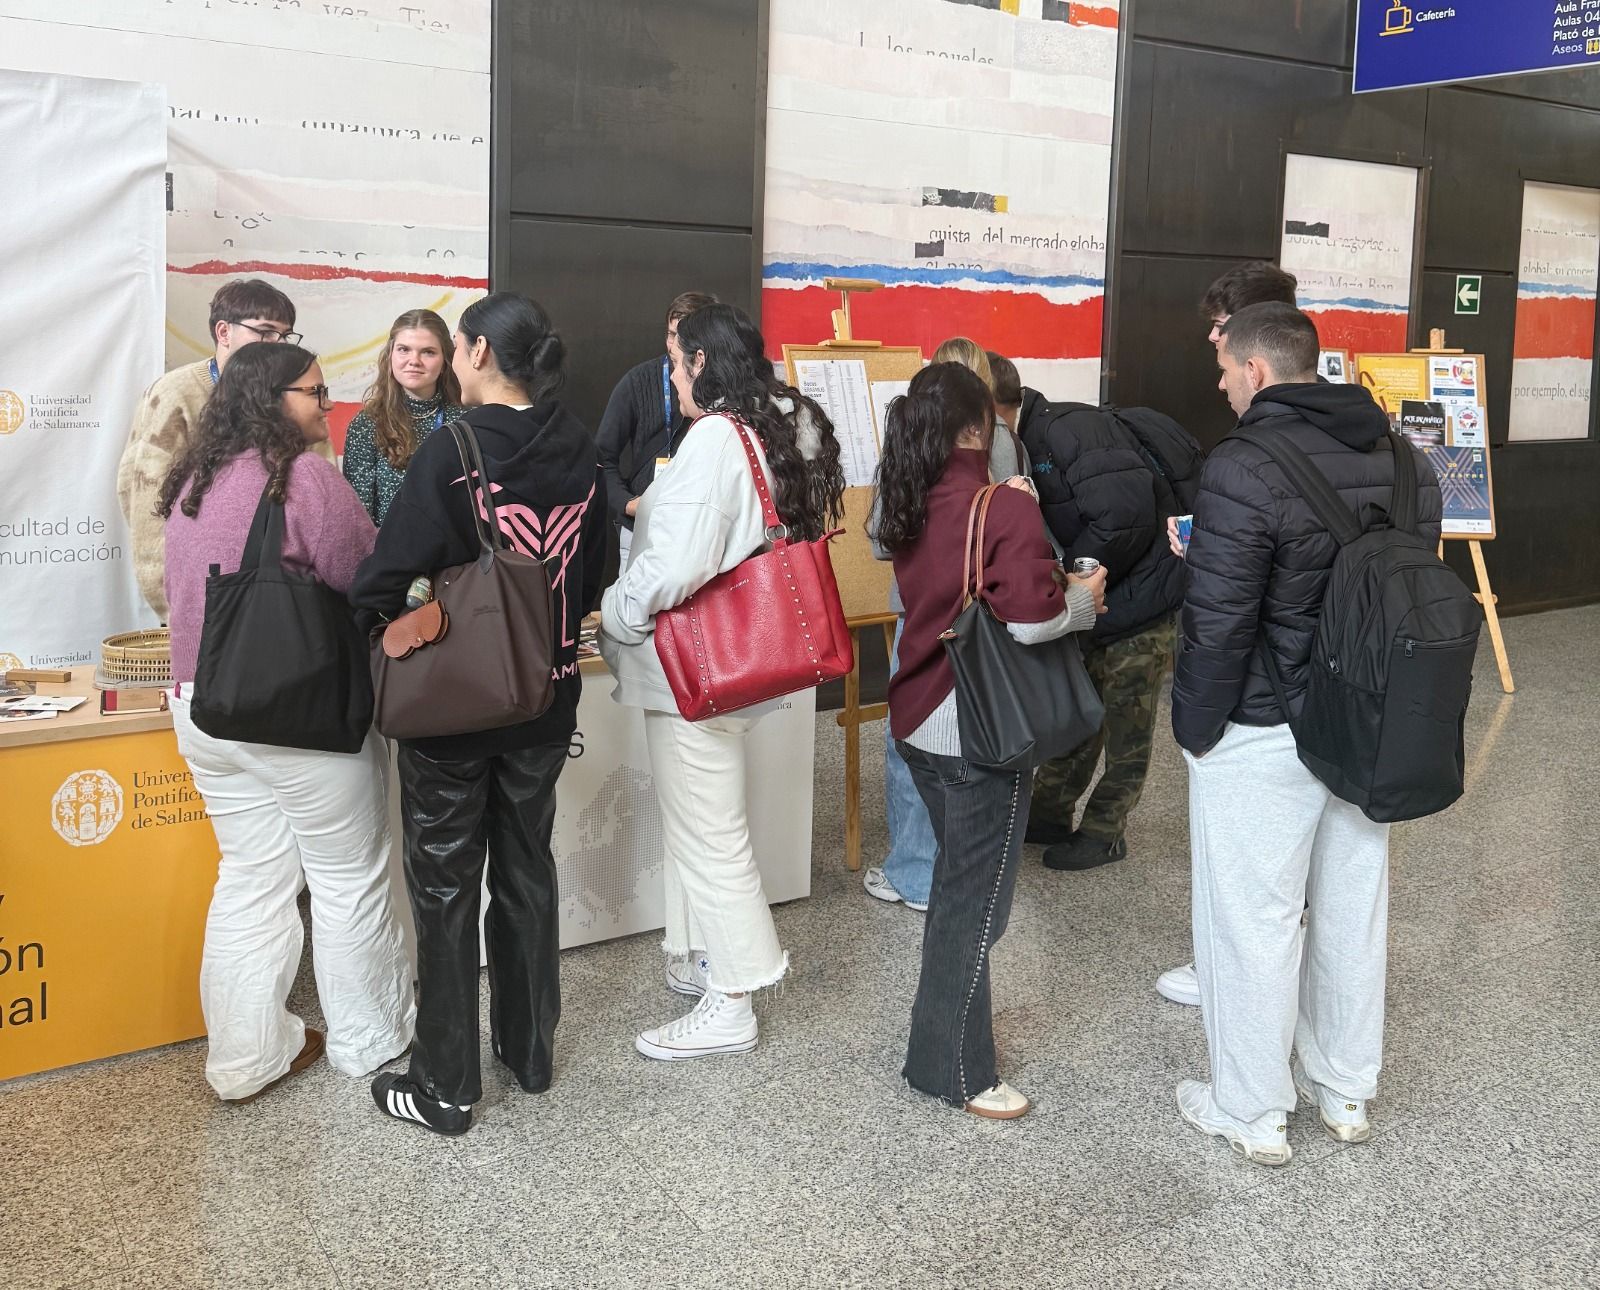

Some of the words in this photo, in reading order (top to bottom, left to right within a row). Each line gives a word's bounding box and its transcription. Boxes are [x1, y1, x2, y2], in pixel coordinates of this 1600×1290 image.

[1415, 7, 1456, 22] Cafetería
[1554, 1, 1578, 14] Aula
[1553, 15, 1582, 28] Aulas
[1553, 28, 1579, 42] Plató
[1581, 26, 1595, 37] de
[1552, 43, 1583, 56] Aseos
[983, 226, 1003, 244] del
[1514, 386, 1531, 399] por
[1569, 383, 1577, 398] el
[30, 394, 92, 405] Universidad
[30, 407, 79, 417] Pontificia
[29, 420, 43, 430] de
[43, 418, 101, 430] Salamanca
[0, 517, 69, 538] cultad
[76, 515, 106, 536] de
[30, 651, 92, 666] Universidad
[131, 813, 152, 830] de
